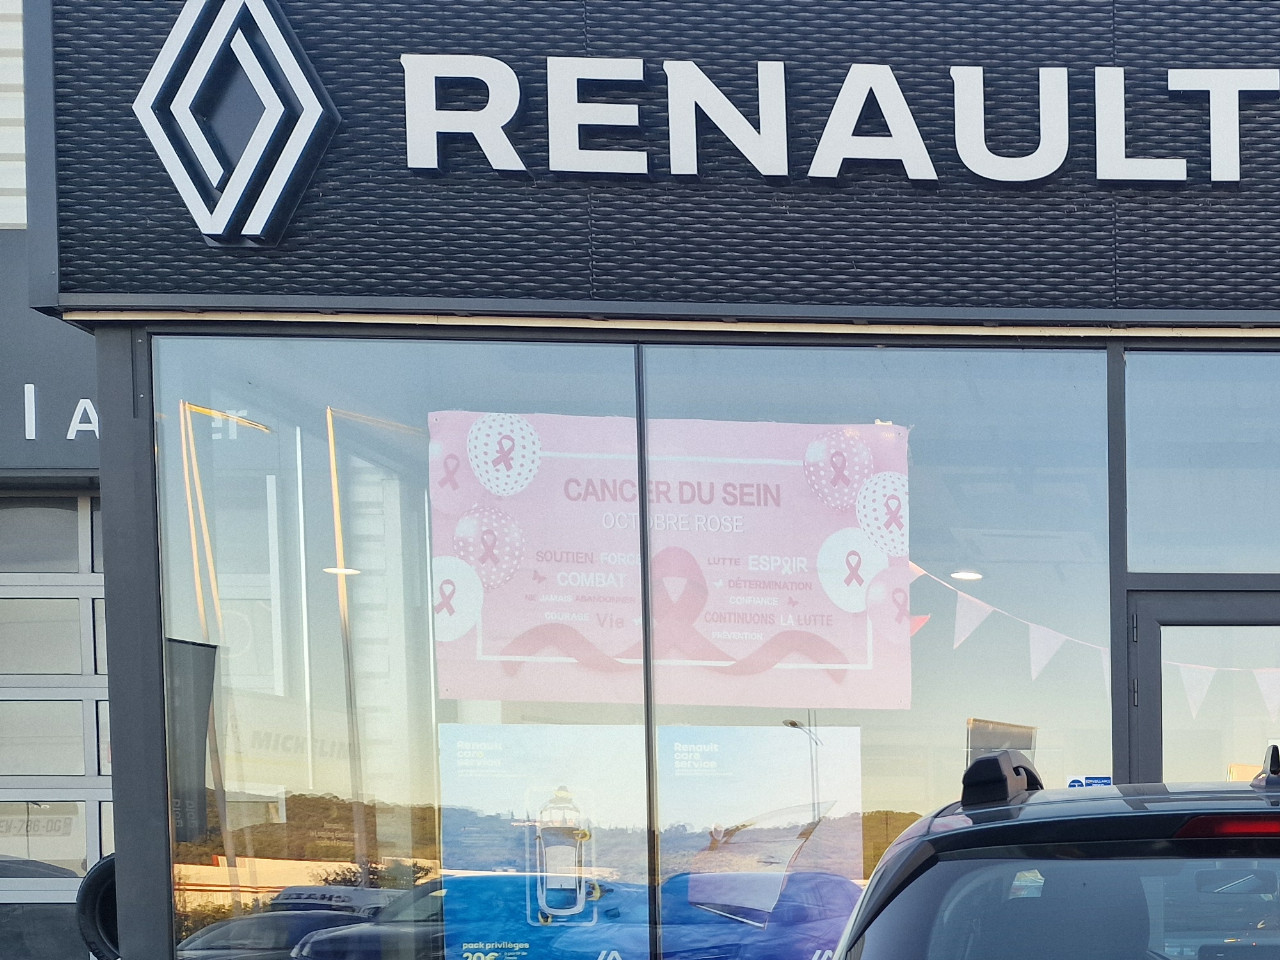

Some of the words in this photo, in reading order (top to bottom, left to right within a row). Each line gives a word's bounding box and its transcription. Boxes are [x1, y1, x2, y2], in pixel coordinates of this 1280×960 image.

[400, 54, 1280, 182] RENAULT
[679, 480, 715, 506] DU
[722, 482, 781, 507] SEIN
[602, 512, 690, 531] OCTBRE
[695, 515, 744, 533] ROSE
[536, 550, 594, 564] SOUTIEN
[707, 557, 741, 566] LUTTE
[557, 571, 627, 588] COMBAT
[596, 612, 625, 628] Vie
[704, 611, 776, 624] CONTINUONS
[780, 614, 795, 626] LA
[797, 614, 833, 627] LUTTE
[674, 742, 719, 751] Renault
[674, 761, 717, 769] service
[462, 942, 484, 950] pack
[486, 941, 529, 951] privilèges
